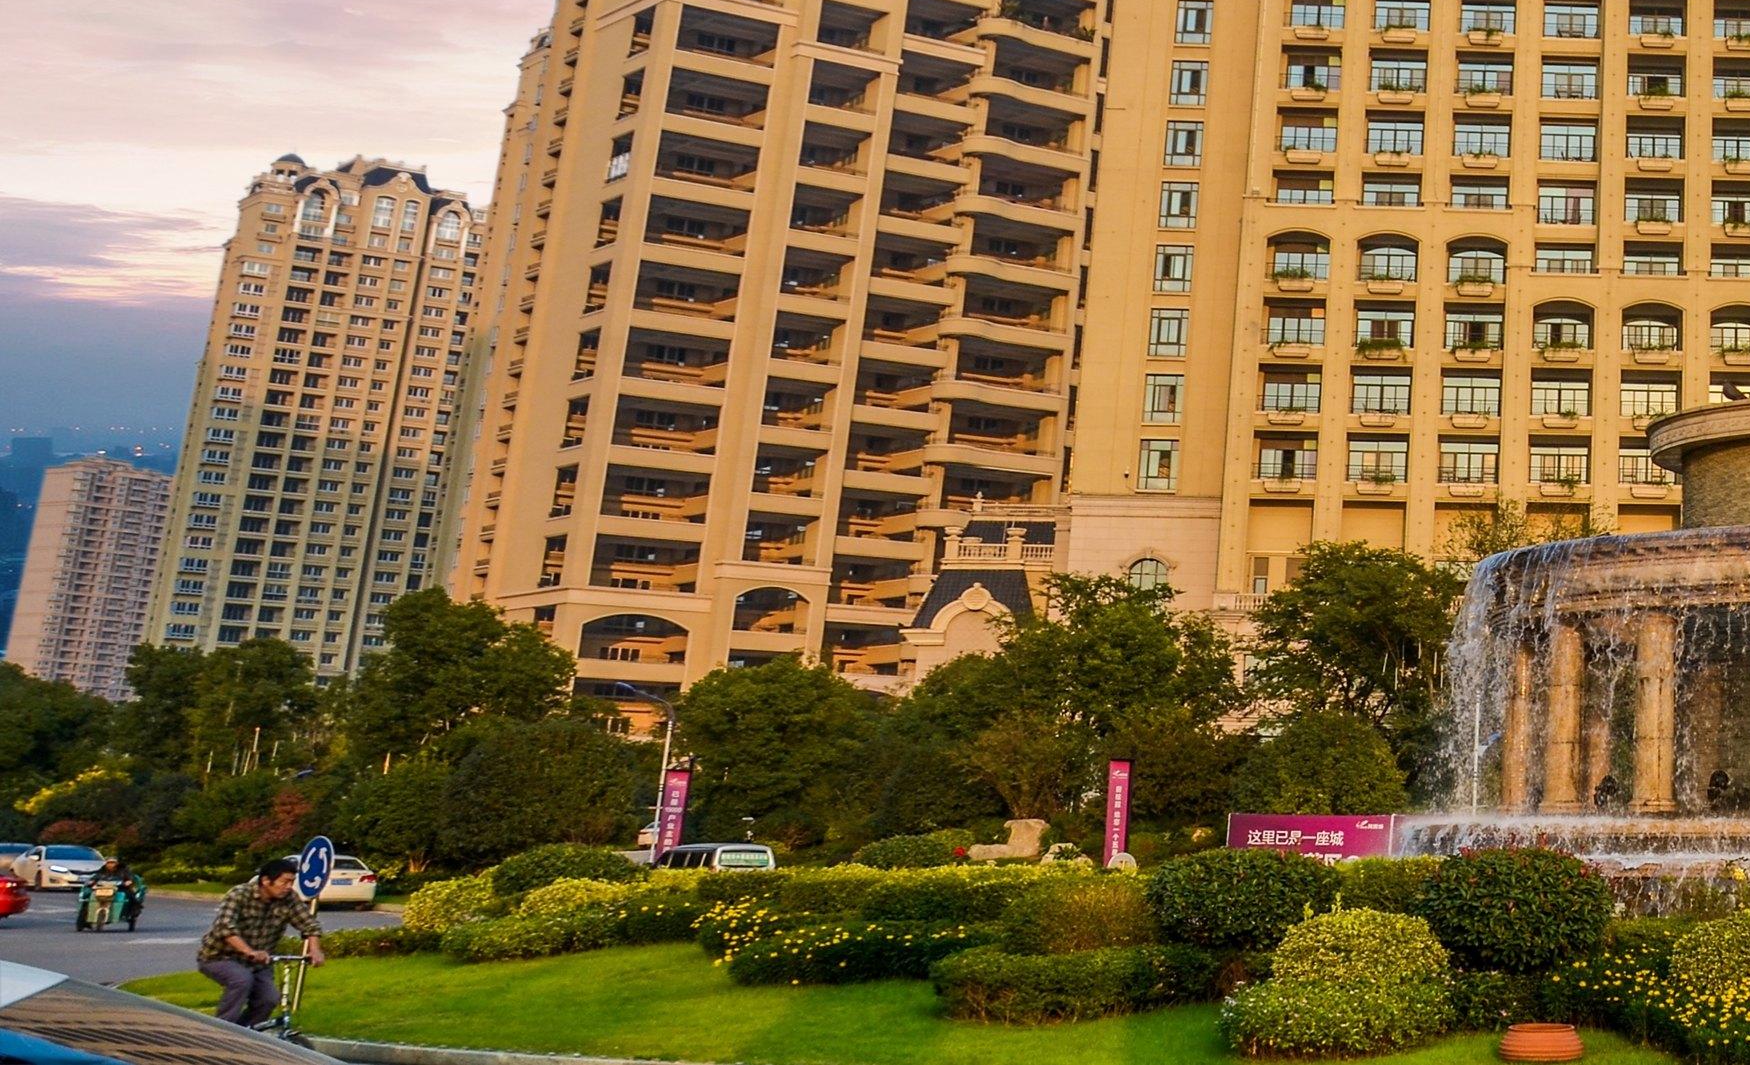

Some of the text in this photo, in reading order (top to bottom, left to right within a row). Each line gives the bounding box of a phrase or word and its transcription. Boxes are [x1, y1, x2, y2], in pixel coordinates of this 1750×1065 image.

[1247, 830, 1344, 847] 这里已是一座城
